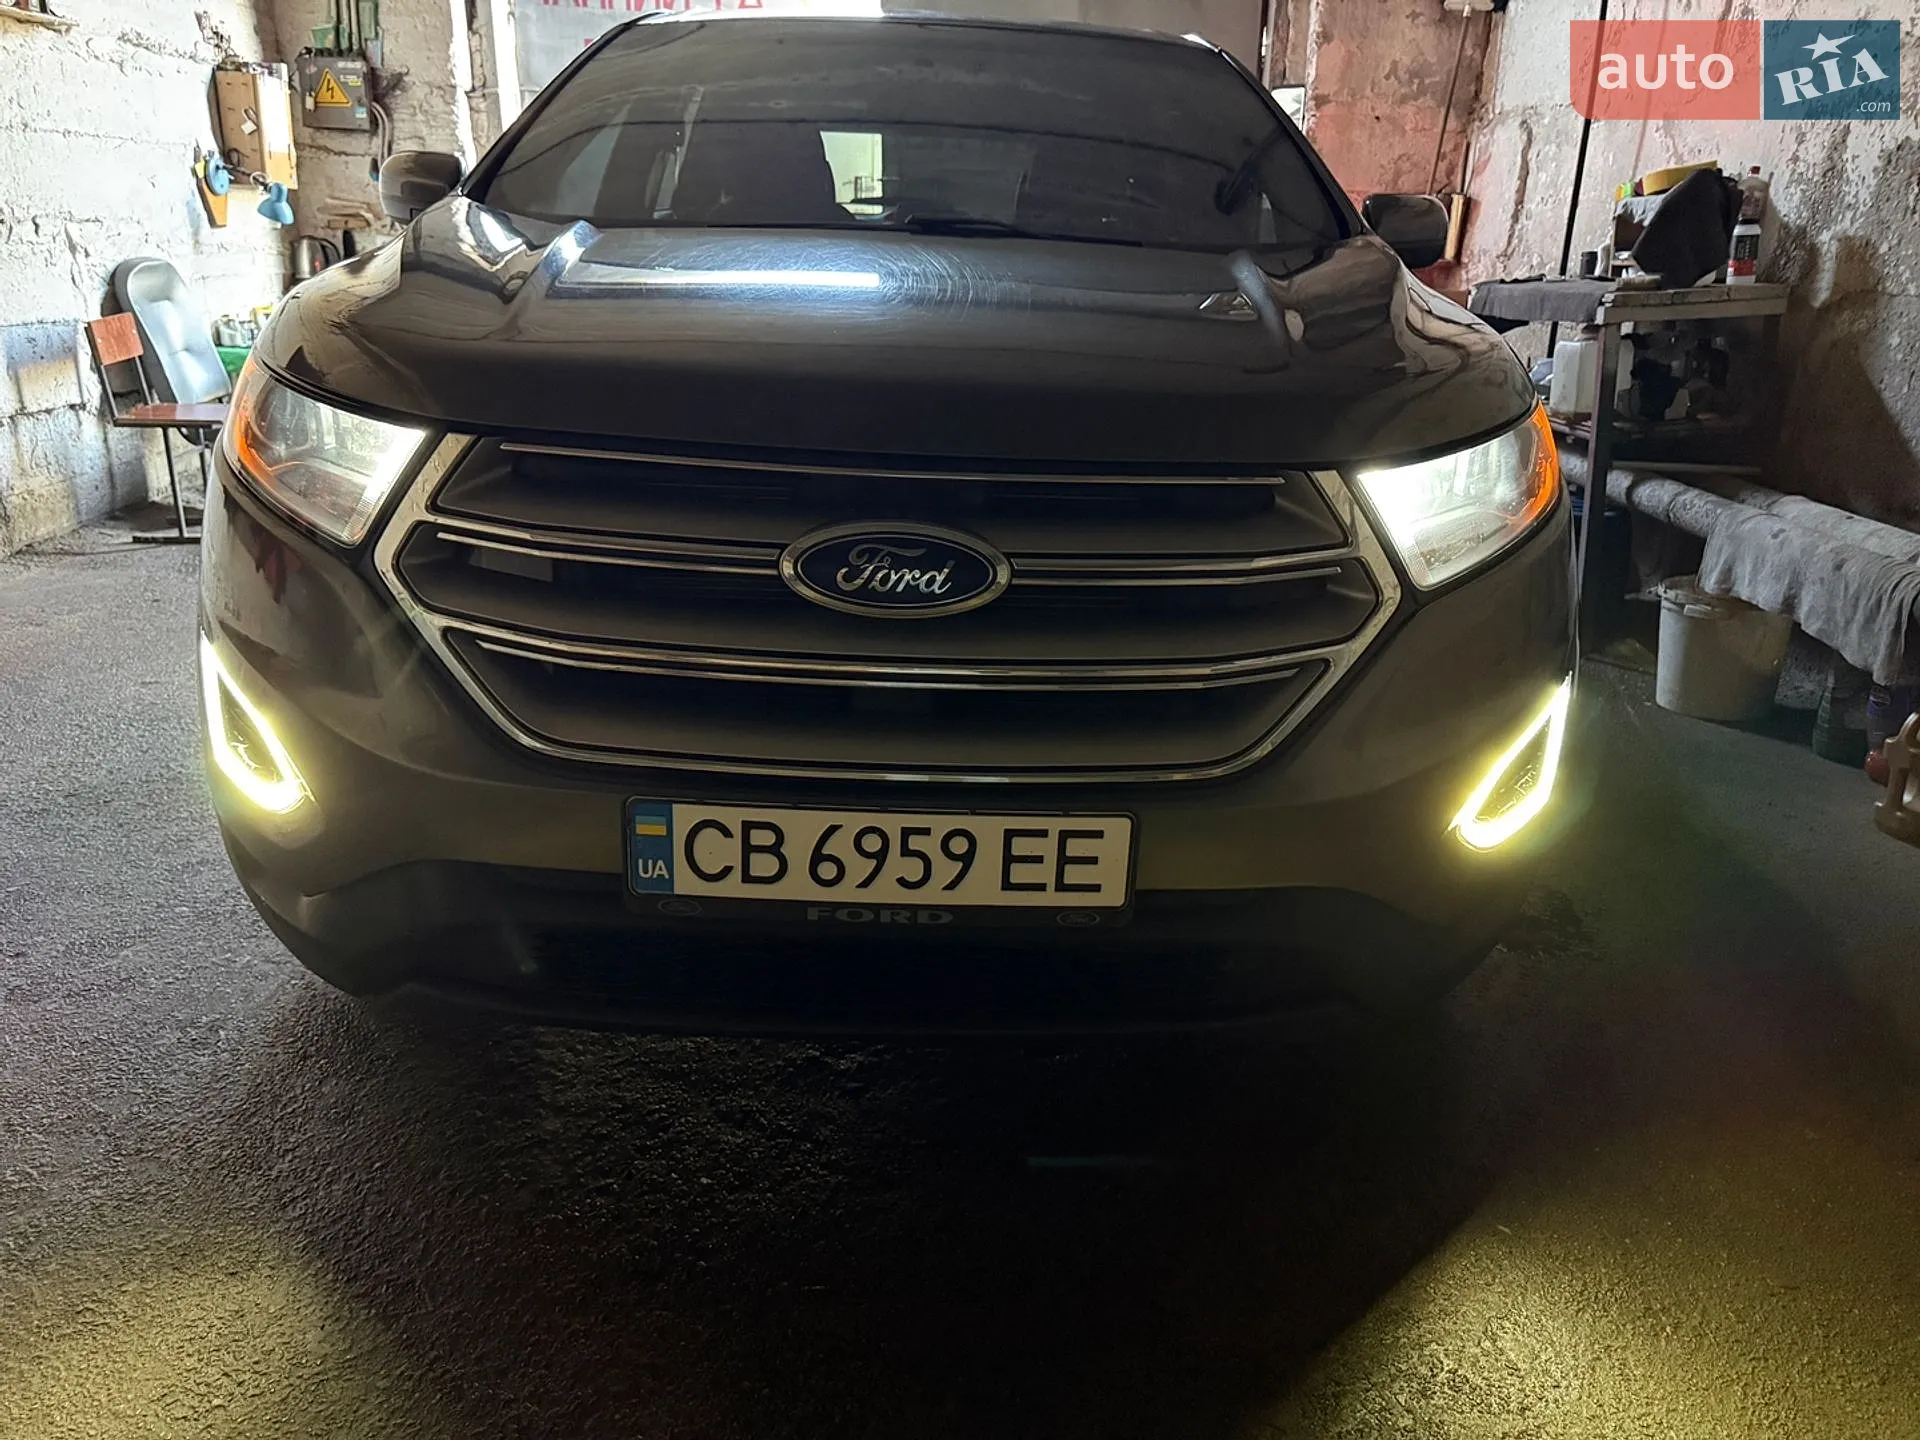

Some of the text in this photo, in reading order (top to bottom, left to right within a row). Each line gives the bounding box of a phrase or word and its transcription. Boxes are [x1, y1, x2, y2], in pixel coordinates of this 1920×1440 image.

[836, 543, 955, 595] Ford
[638, 859, 669, 879] UA
[684, 819, 1105, 893] CB 6959 EE
[806, 906, 954, 925] FORD
